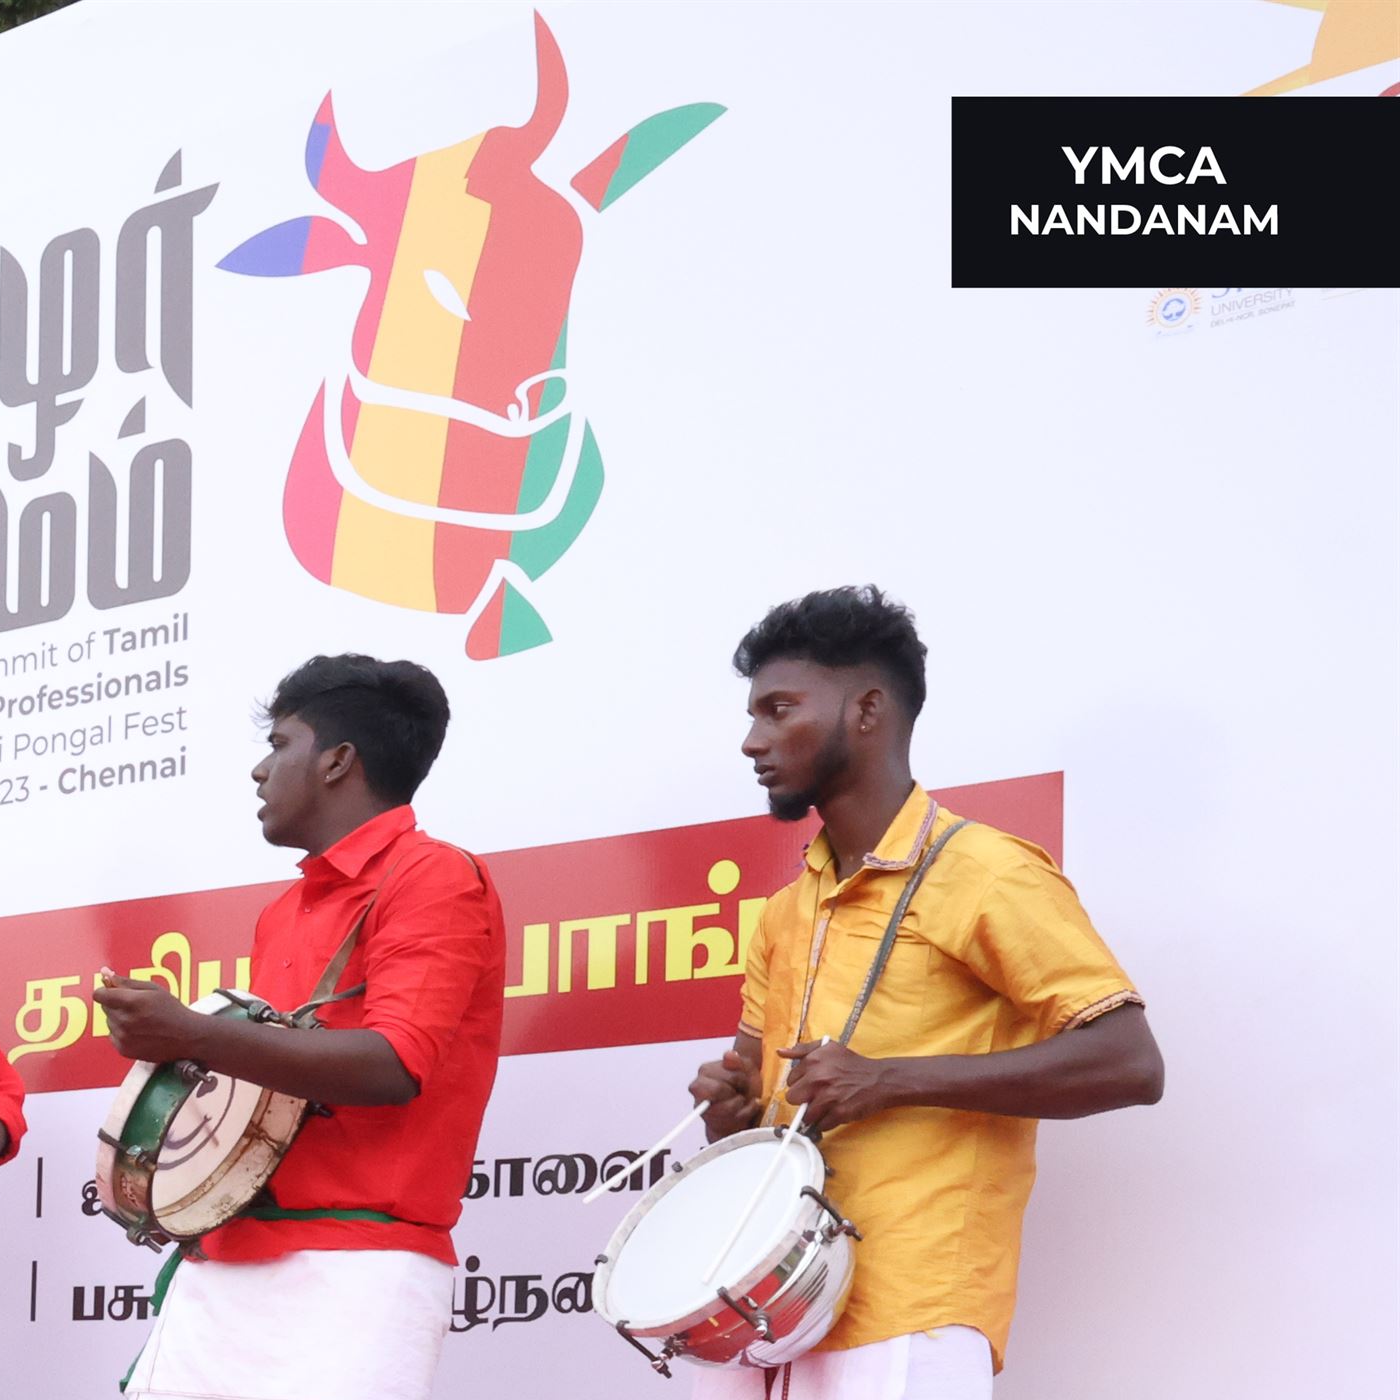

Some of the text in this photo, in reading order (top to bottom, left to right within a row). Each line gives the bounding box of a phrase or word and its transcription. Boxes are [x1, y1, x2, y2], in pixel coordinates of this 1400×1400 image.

[1212, 288, 1294, 316] UNIVERSITY
[67, 632, 96, 663] of
[103, 612, 190, 656] Tamil
[13, 714, 113, 762] Pongal
[122, 705, 188, 741] Fest
[57, 746, 188, 795] Chennai
